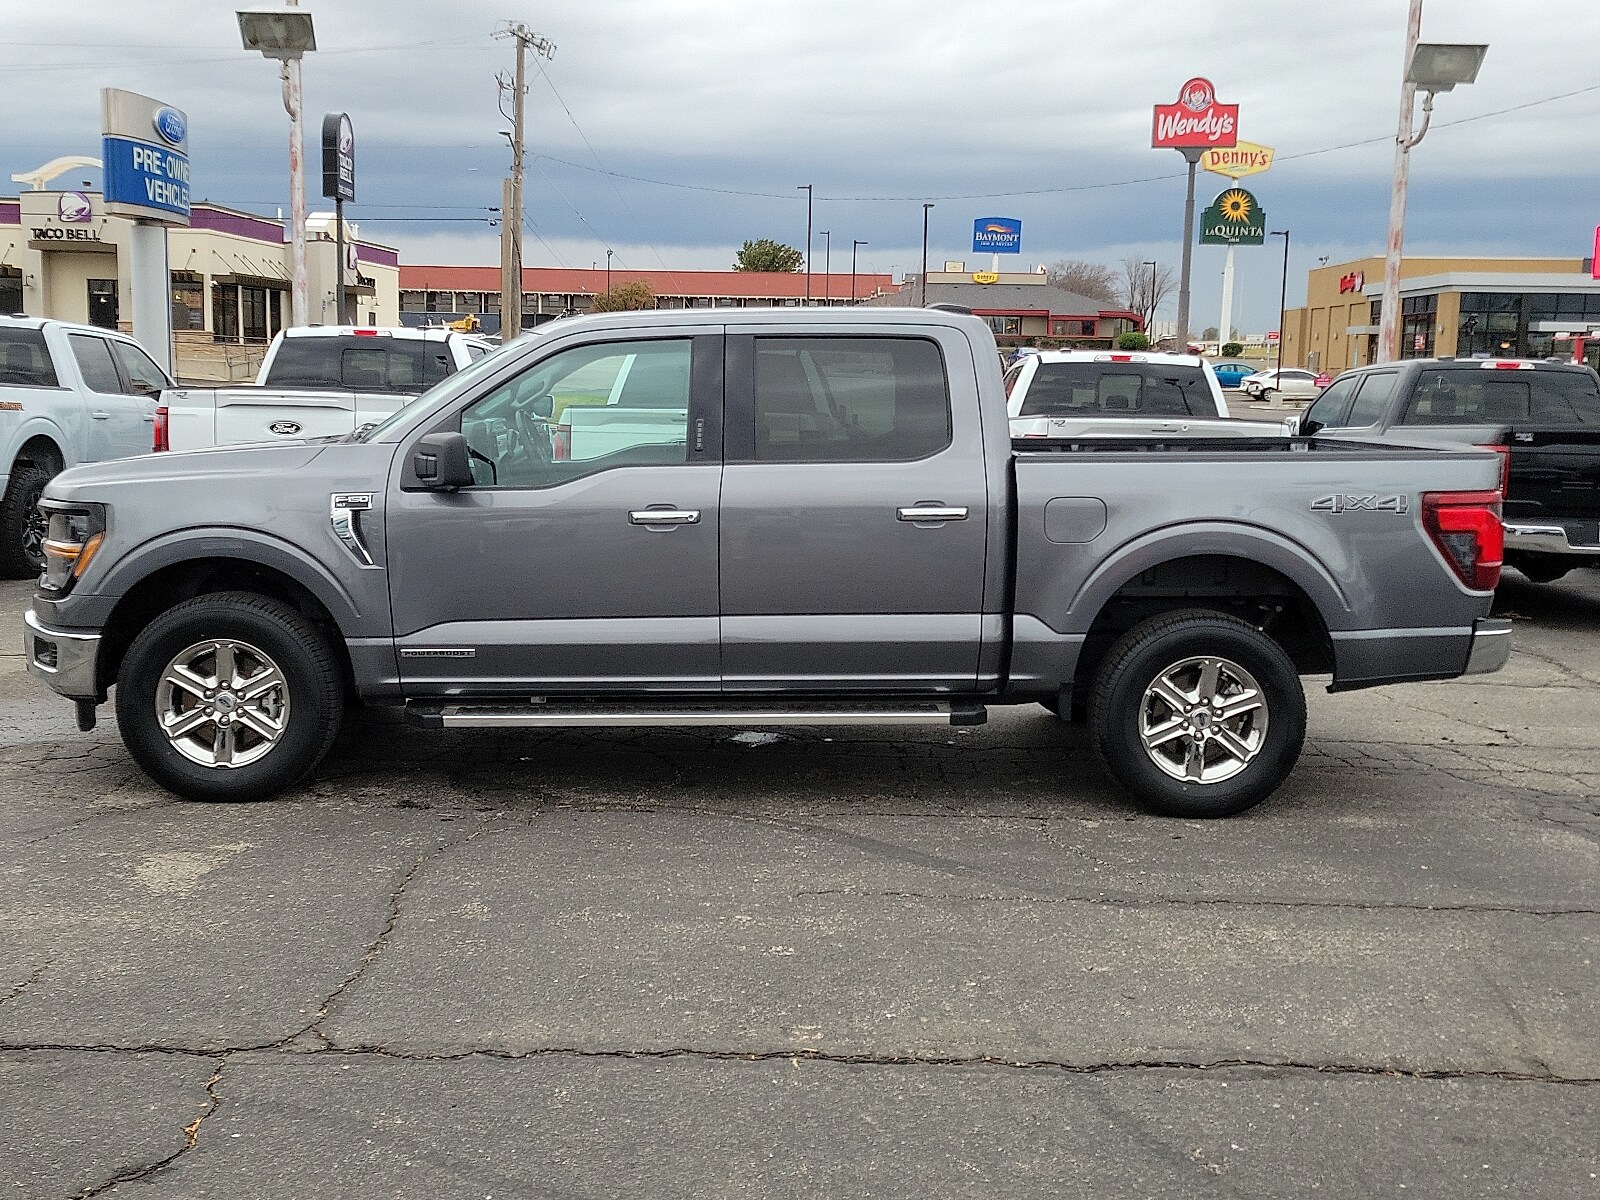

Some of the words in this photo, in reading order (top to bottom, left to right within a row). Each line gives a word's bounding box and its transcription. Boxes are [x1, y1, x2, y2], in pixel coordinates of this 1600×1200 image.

[1157, 108, 1234, 141] Wendy's
[133, 146, 189, 183] PRE-OWNE
[1210, 150, 1268, 167] Denny's
[30, 228, 63, 239] TACO
[66, 229, 100, 240] BELL
[975, 232, 1019, 241] BAYMONT
[1215, 225, 1263, 238] QUINTA
[272, 424, 297, 433] Ford
